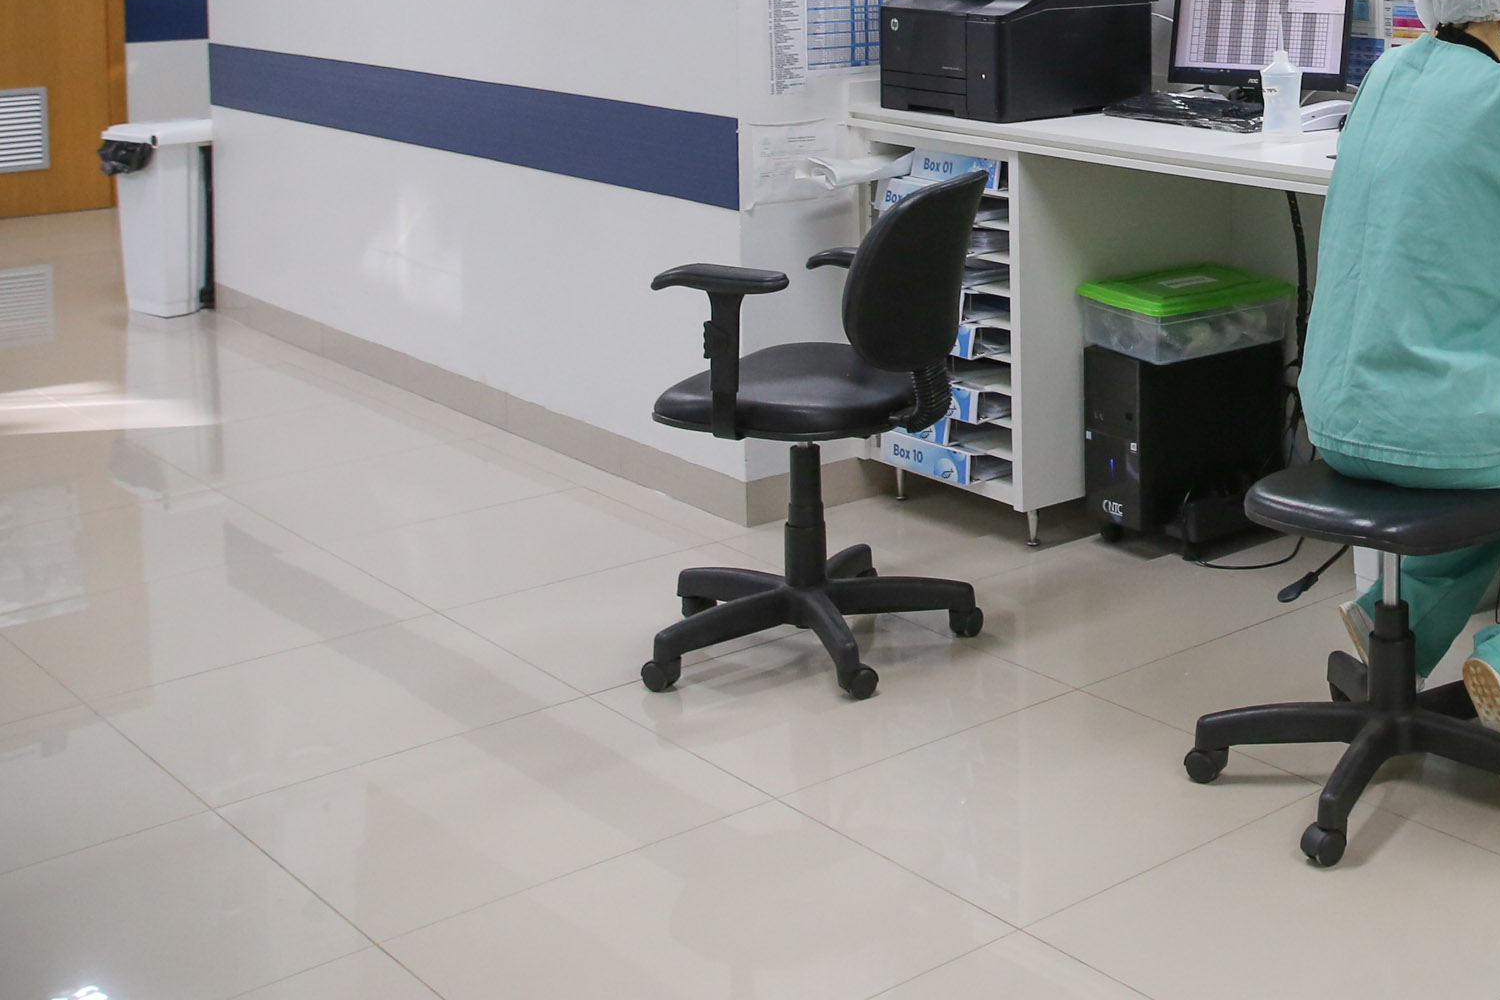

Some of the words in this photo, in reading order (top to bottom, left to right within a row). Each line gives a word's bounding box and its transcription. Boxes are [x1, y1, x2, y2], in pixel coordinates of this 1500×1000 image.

[923, 158, 941, 172] Box
[943, 161, 953, 175] 01
[893, 443, 910, 460] Box
[913, 449, 923, 463] 10
